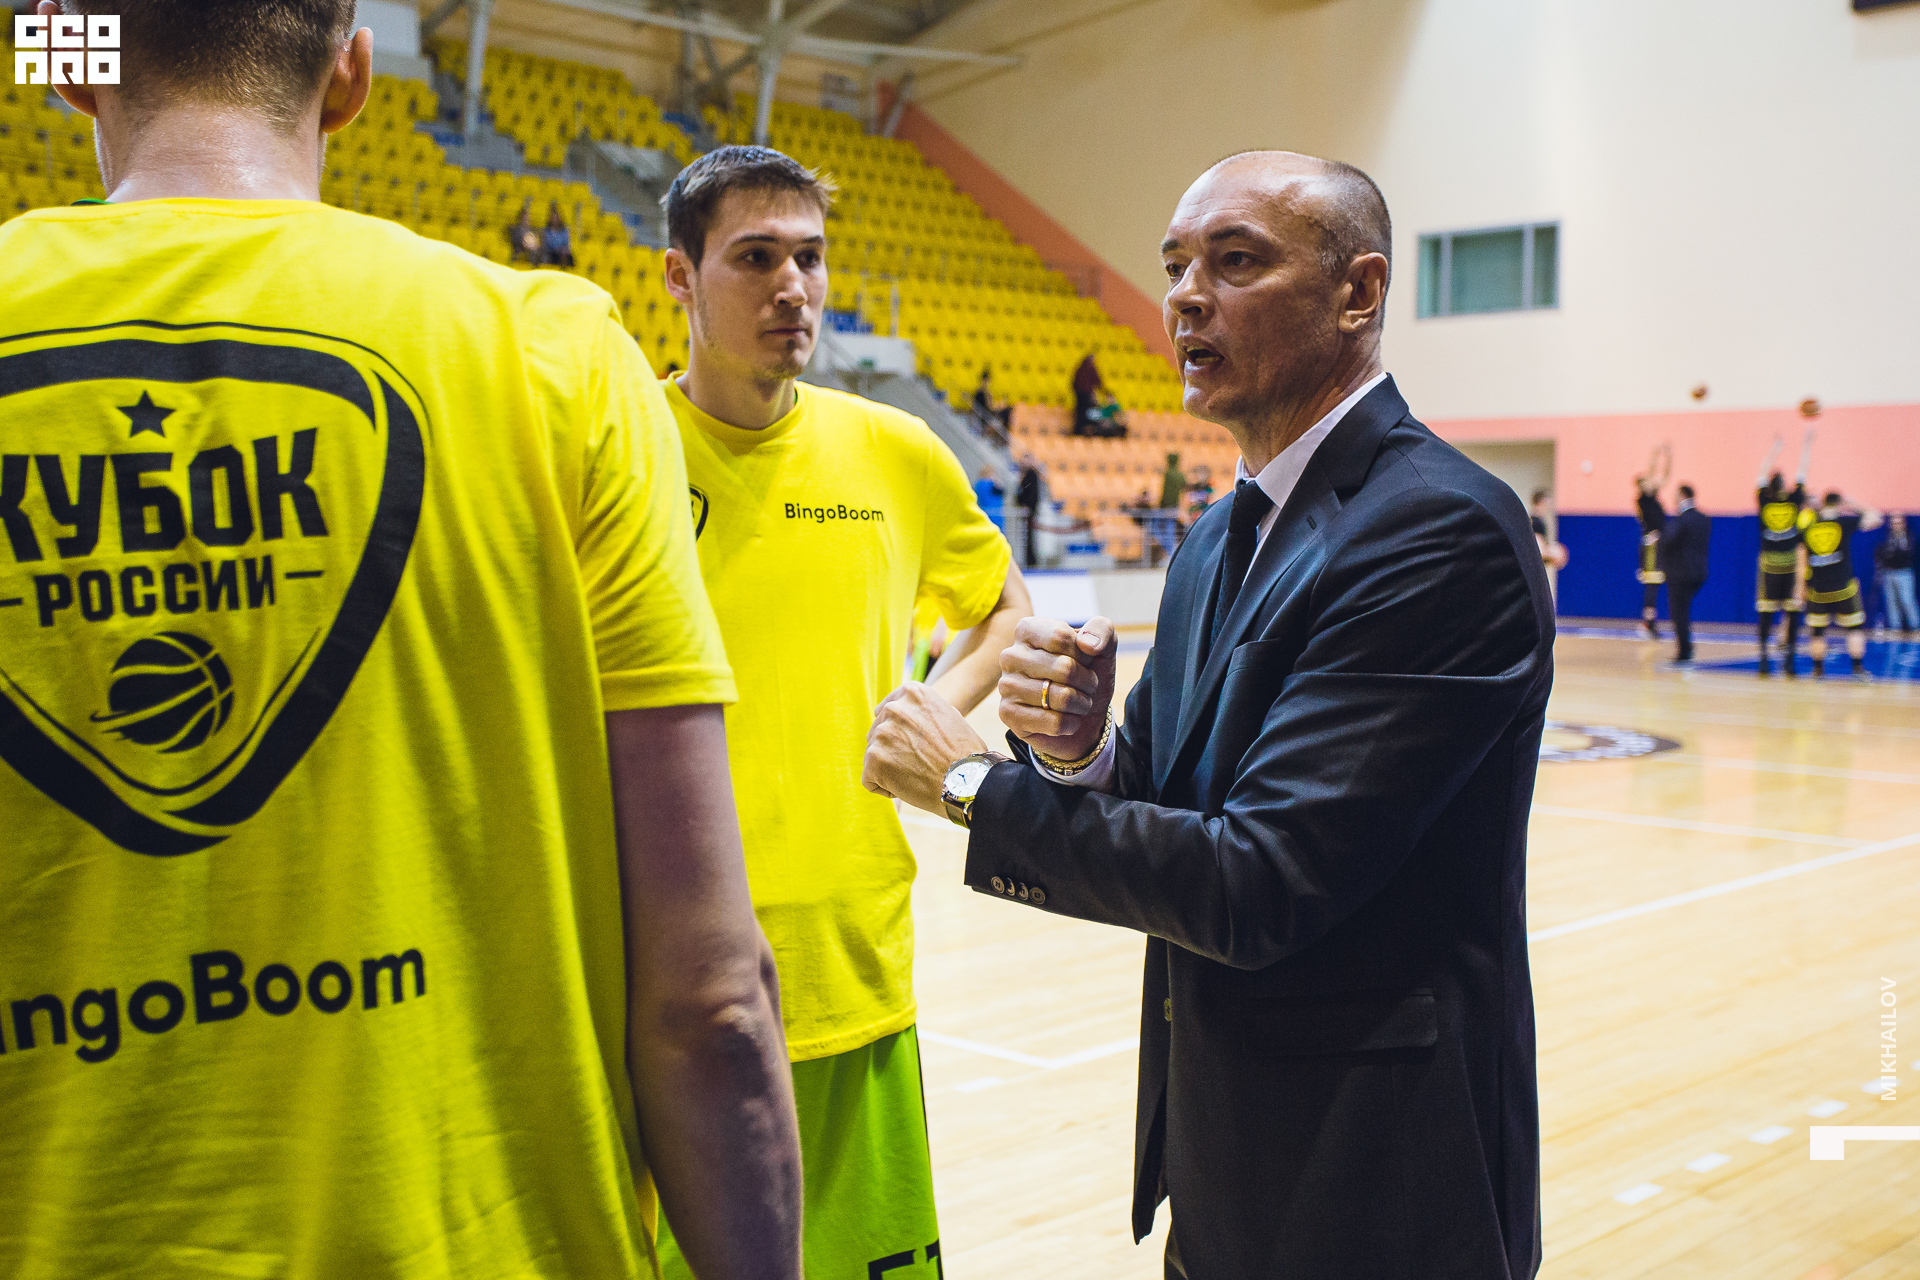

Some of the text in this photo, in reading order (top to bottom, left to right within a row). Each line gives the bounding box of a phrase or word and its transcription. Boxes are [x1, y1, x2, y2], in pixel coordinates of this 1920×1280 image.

[785, 502, 885, 523] BingoBoom
[33, 554, 275, 627] РОССИИ
[0, 948, 426, 1063] ngoBoom
